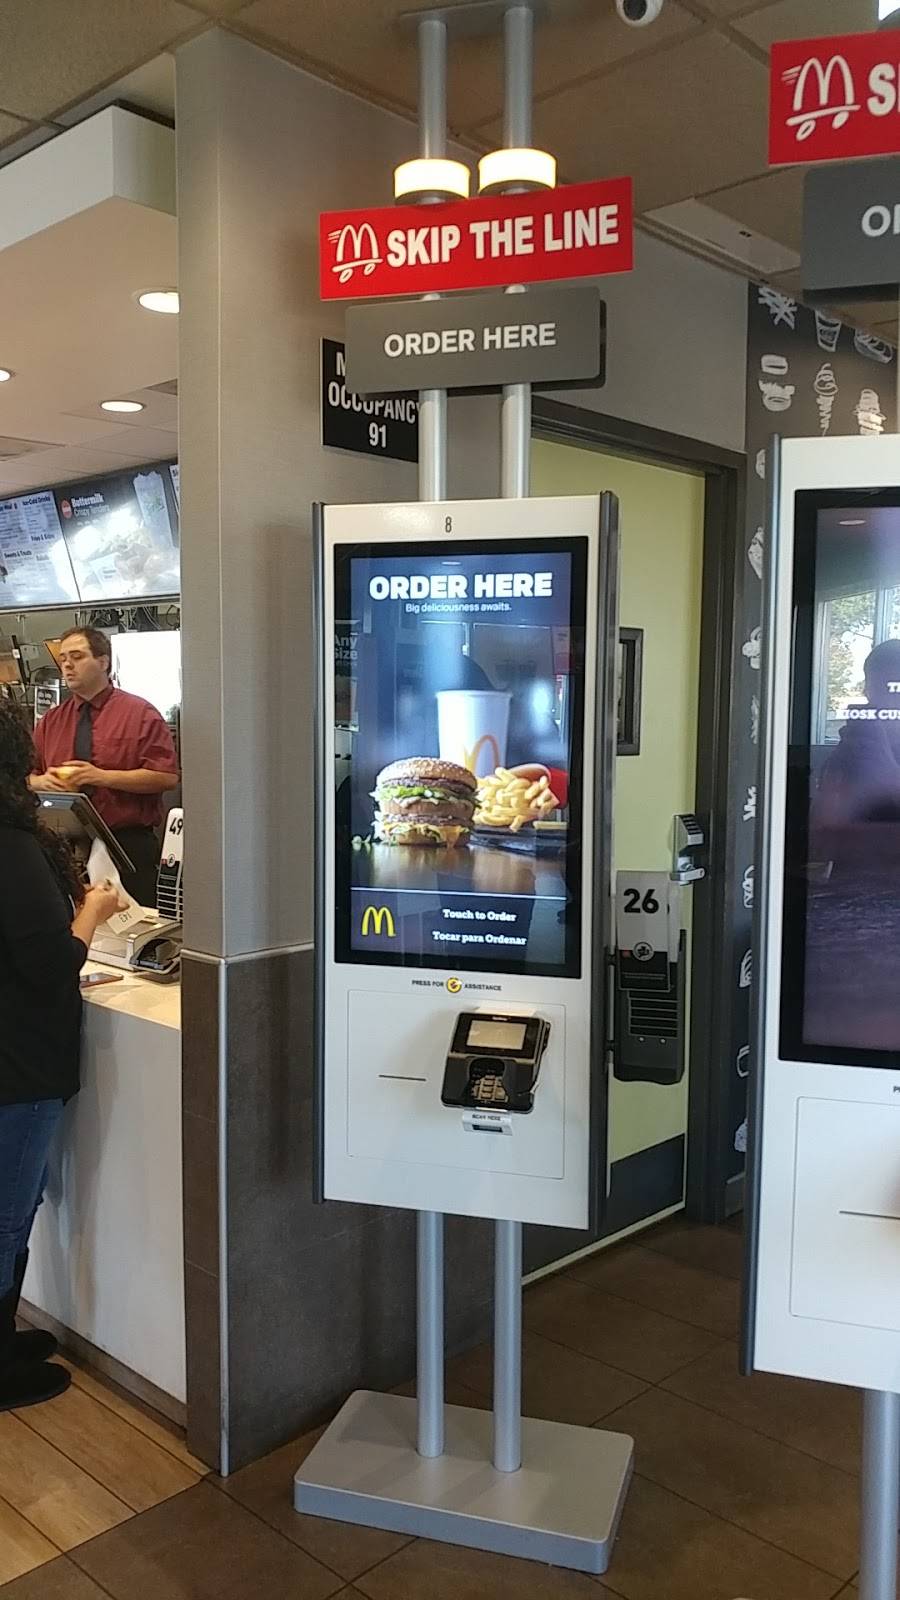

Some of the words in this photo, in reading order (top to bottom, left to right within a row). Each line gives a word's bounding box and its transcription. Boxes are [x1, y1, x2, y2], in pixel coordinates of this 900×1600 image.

[867, 63, 900, 117] S
[861, 203, 900, 238] O
[386, 224, 461, 268] SKIP
[469, 216, 534, 259] THE
[544, 204, 619, 252] LINE
[384, 328, 475, 358] ORDER
[483, 323, 556, 350] HERE
[328, 381, 419, 424] OCCUPANC
[369, 422, 387, 448] 91
[71, 492, 104, 508] Buttermilk
[444, 516, 452, 533] 8
[369, 574, 468, 600] ORDER
[474, 572, 553, 599] HERE
[405, 603, 420, 614] Big
[421, 602, 480, 612] deliciousness
[836, 708, 877, 720] KIOSK
[169, 817, 183, 835] 49
[623, 888, 660, 914] 26
[442, 909, 474, 919] Touch
[475, 911, 486, 920] to
[487, 911, 517, 921] Order
[432, 931, 461, 941] Tocar
[461, 934, 484, 944] para
[485, 934, 527, 945] Ordenar
[412, 979, 431, 987] PRESS
[465, 983, 502, 991] ASSISTANCE
